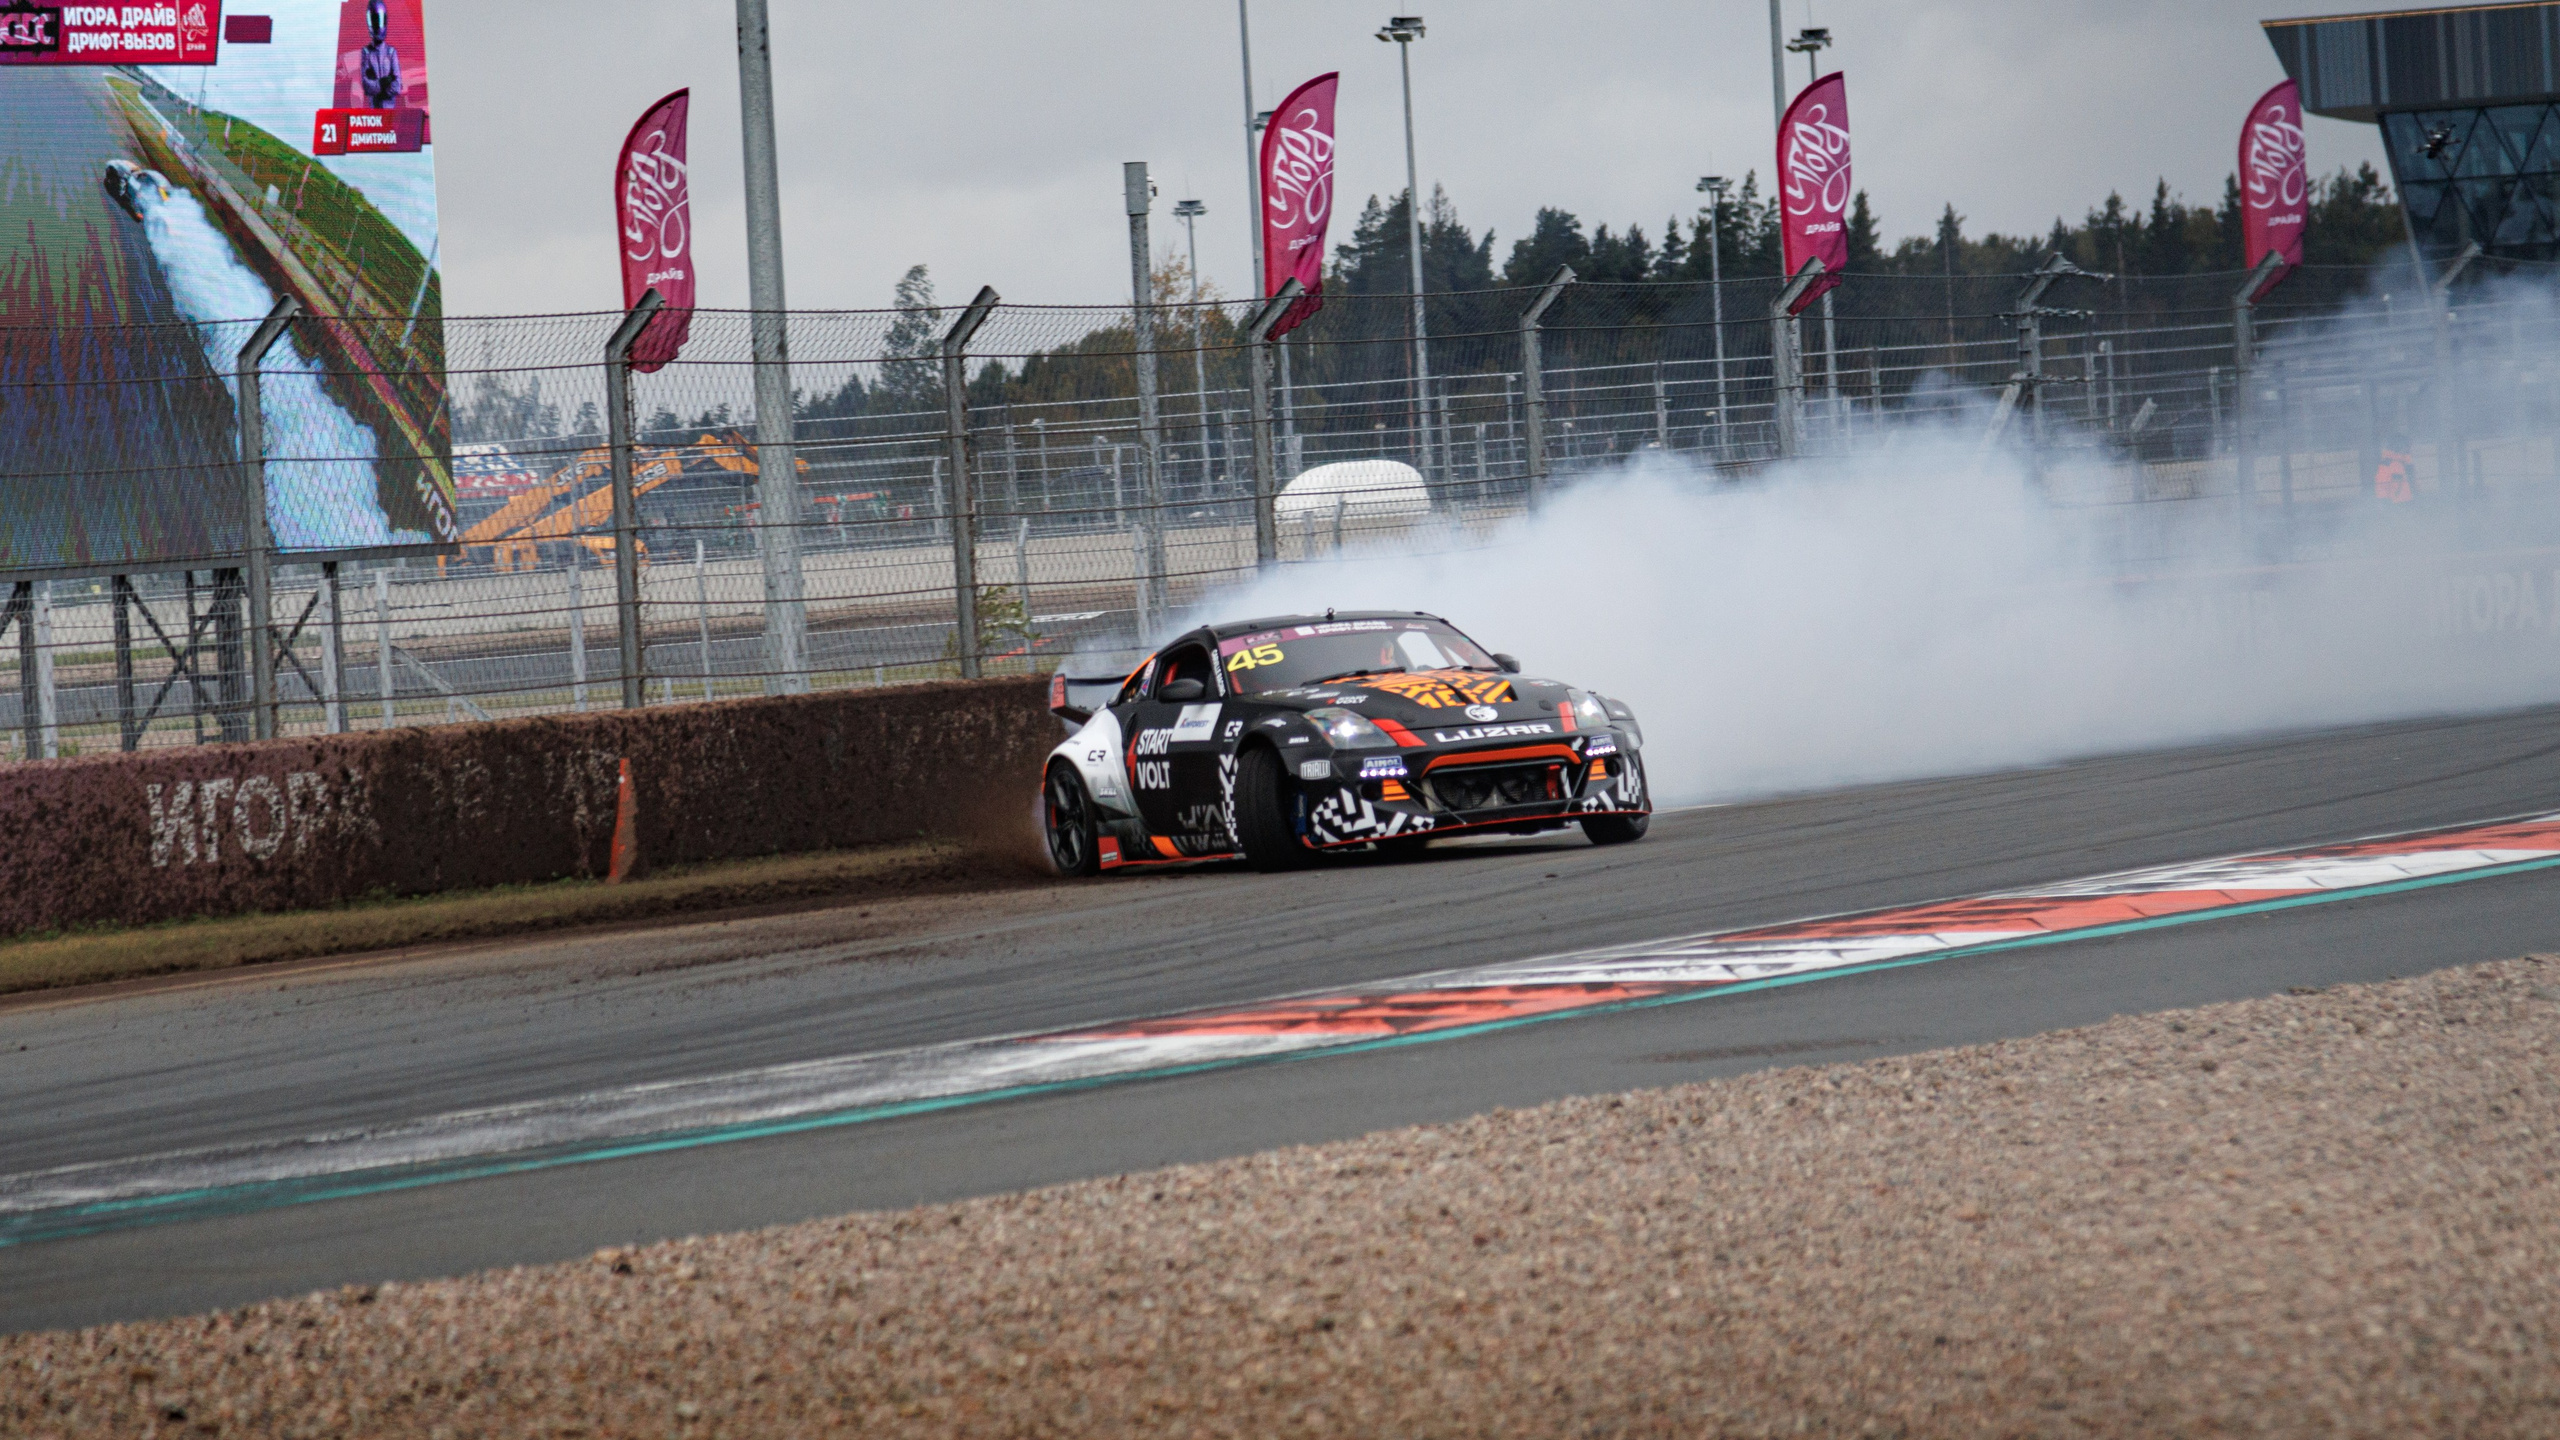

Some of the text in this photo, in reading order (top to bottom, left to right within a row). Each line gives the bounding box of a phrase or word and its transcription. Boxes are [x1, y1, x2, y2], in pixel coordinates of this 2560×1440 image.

[63, 6, 118, 26] ИГОРА
[120, 2, 177, 29] ДРАЙВ
[67, 32, 176, 53] ДРИФТ-ВЫЗОВ
[349, 115, 383, 127] РАТЮК
[321, 123, 337, 143] 21
[351, 130, 397, 146] ДМИТРИЙ
[1805, 221, 1841, 235] ДРАЙВ
[646, 266, 685, 285] ДРАЙВ
[1227, 643, 1284, 672] 45
[1137, 729, 1175, 755] START
[1434, 723, 1555, 743] LUZAR
[1087, 750, 1107, 761] CR
[1136, 761, 1171, 790] VOLT
[1303, 762, 1329, 778] TRIALLI
